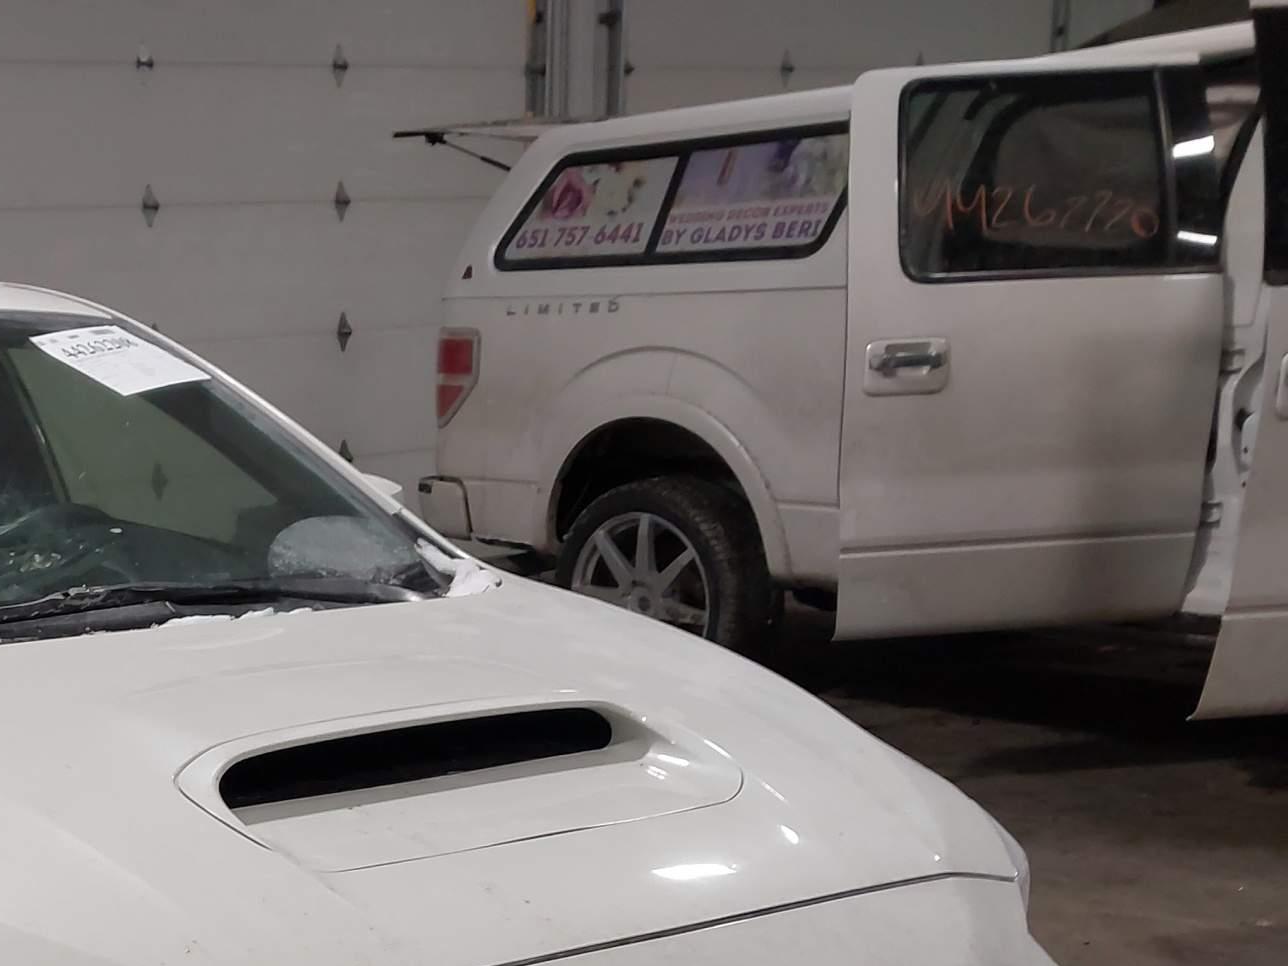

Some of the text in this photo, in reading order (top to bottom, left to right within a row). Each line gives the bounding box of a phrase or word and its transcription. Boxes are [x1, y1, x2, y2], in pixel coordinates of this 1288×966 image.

[727, 205, 771, 220] DECOR
[773, 200, 829, 217] EXPERTS
[516, 222, 645, 249] 651 757 6441
[662, 229, 689, 246] BY
[690, 223, 767, 244] GLADYS
[506, 300, 619, 316] LIMITED
